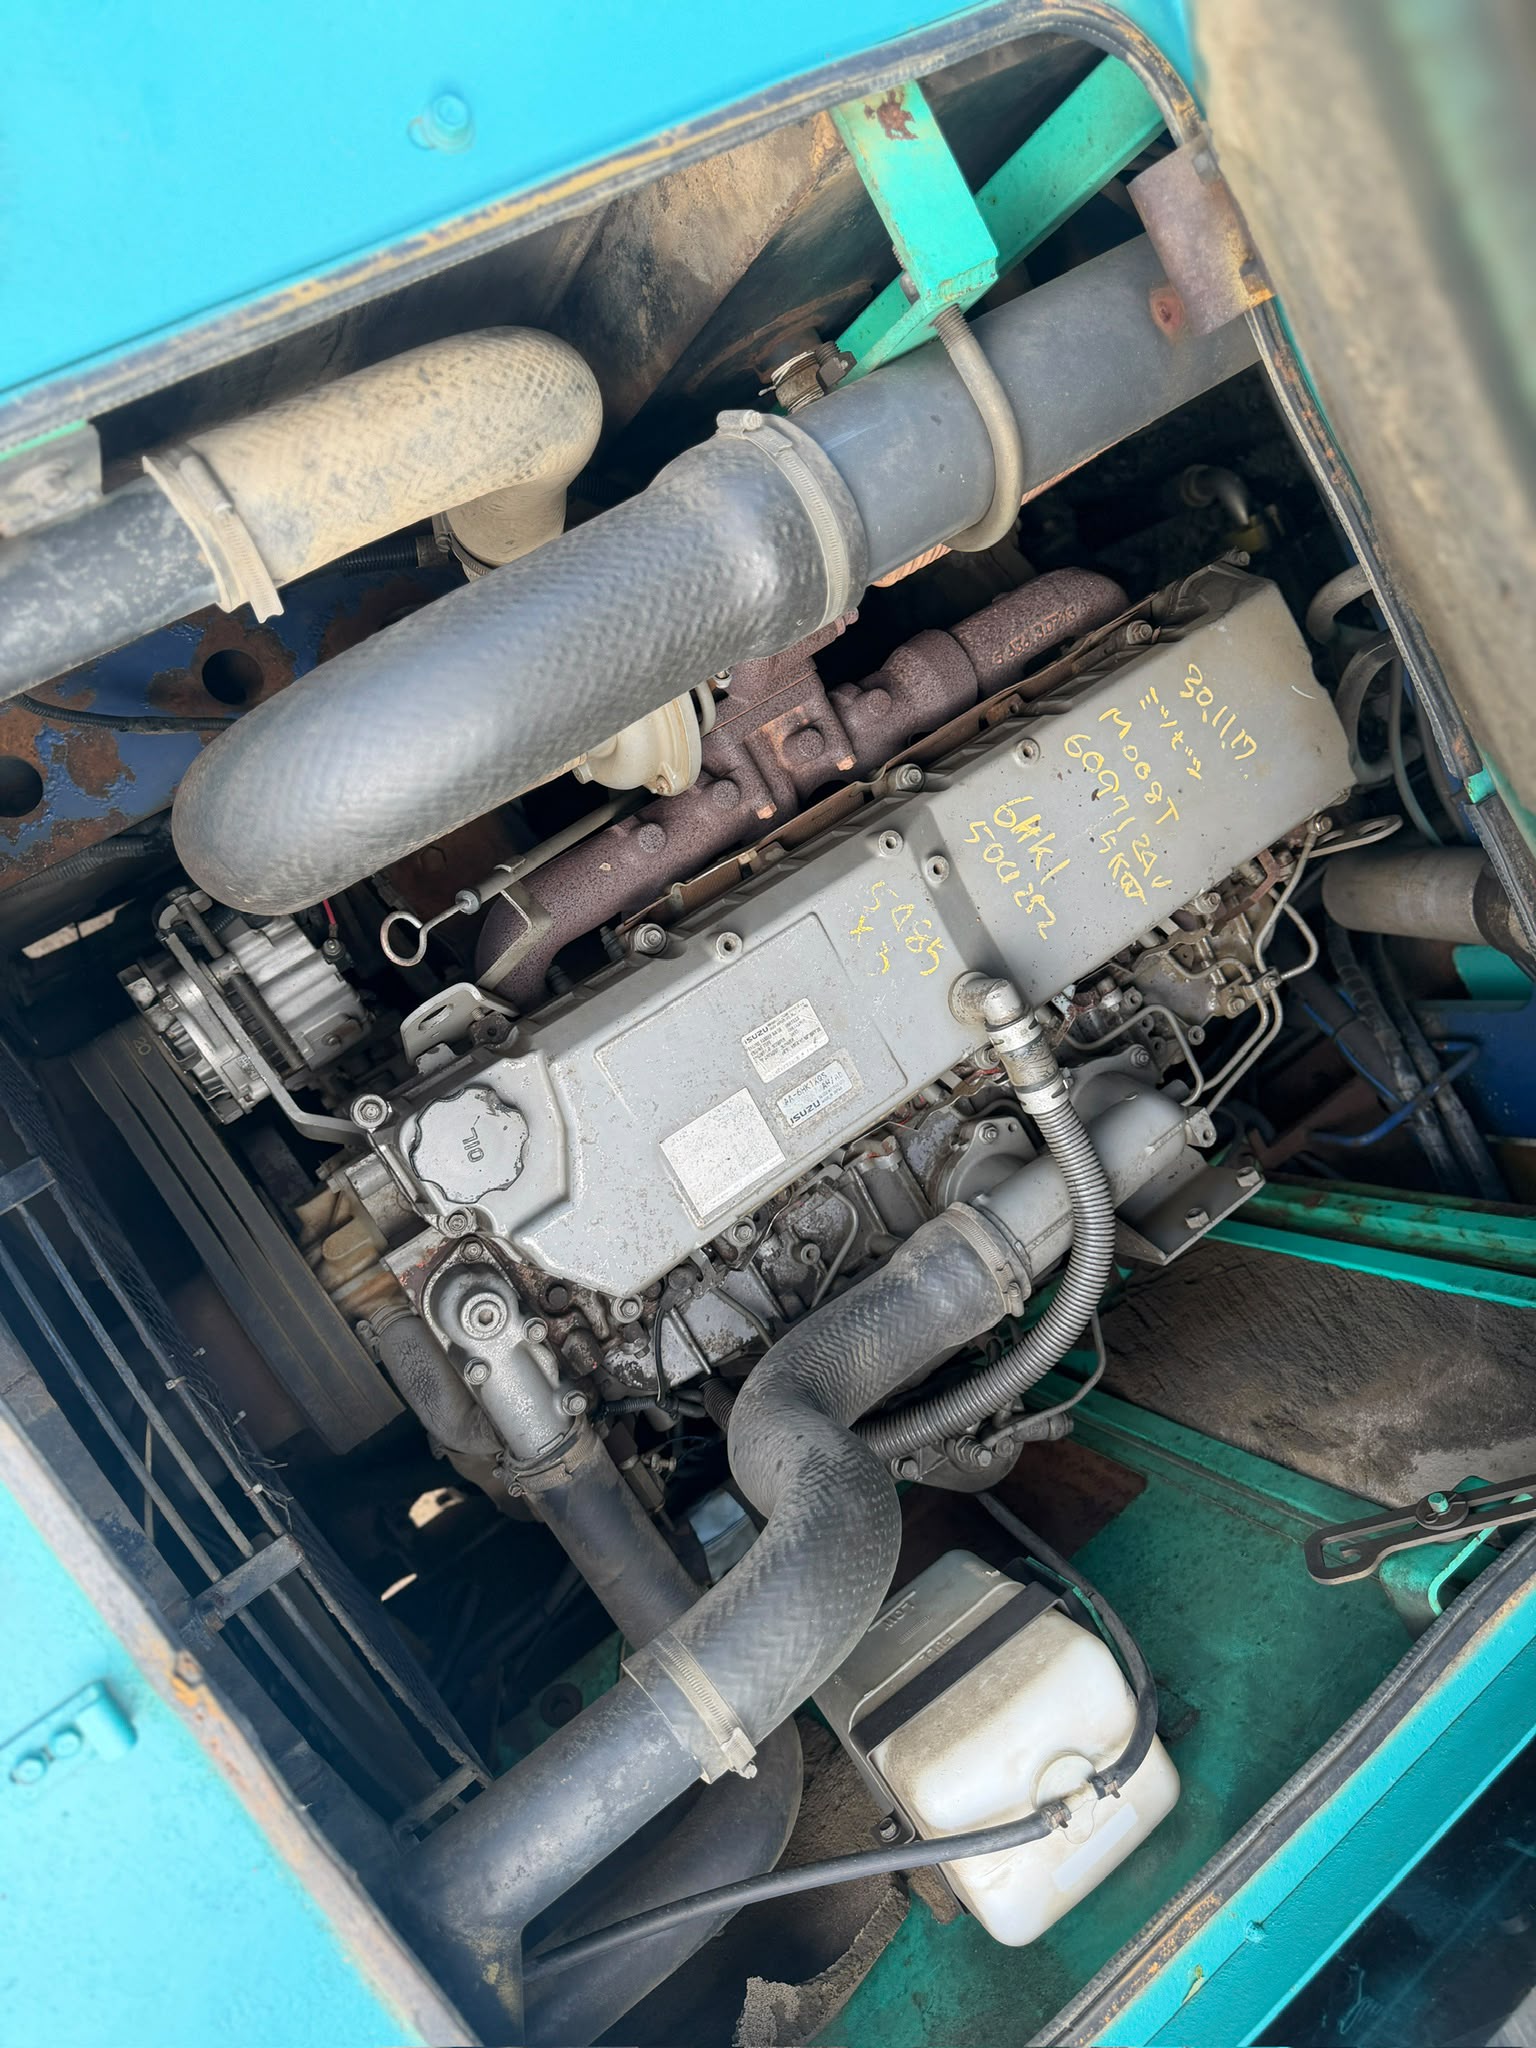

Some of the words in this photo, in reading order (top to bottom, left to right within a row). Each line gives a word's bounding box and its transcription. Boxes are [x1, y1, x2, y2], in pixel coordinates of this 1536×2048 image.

[993, 795, 1071, 886] 6HK1
[744, 1026, 769, 1045] ISUZU
[789, 1099, 821, 1124] ISUZU
[462, 1126, 485, 1163] OIL
[884, 1600, 916, 1632] LOW
[917, 1632, 954, 1662] FULL
